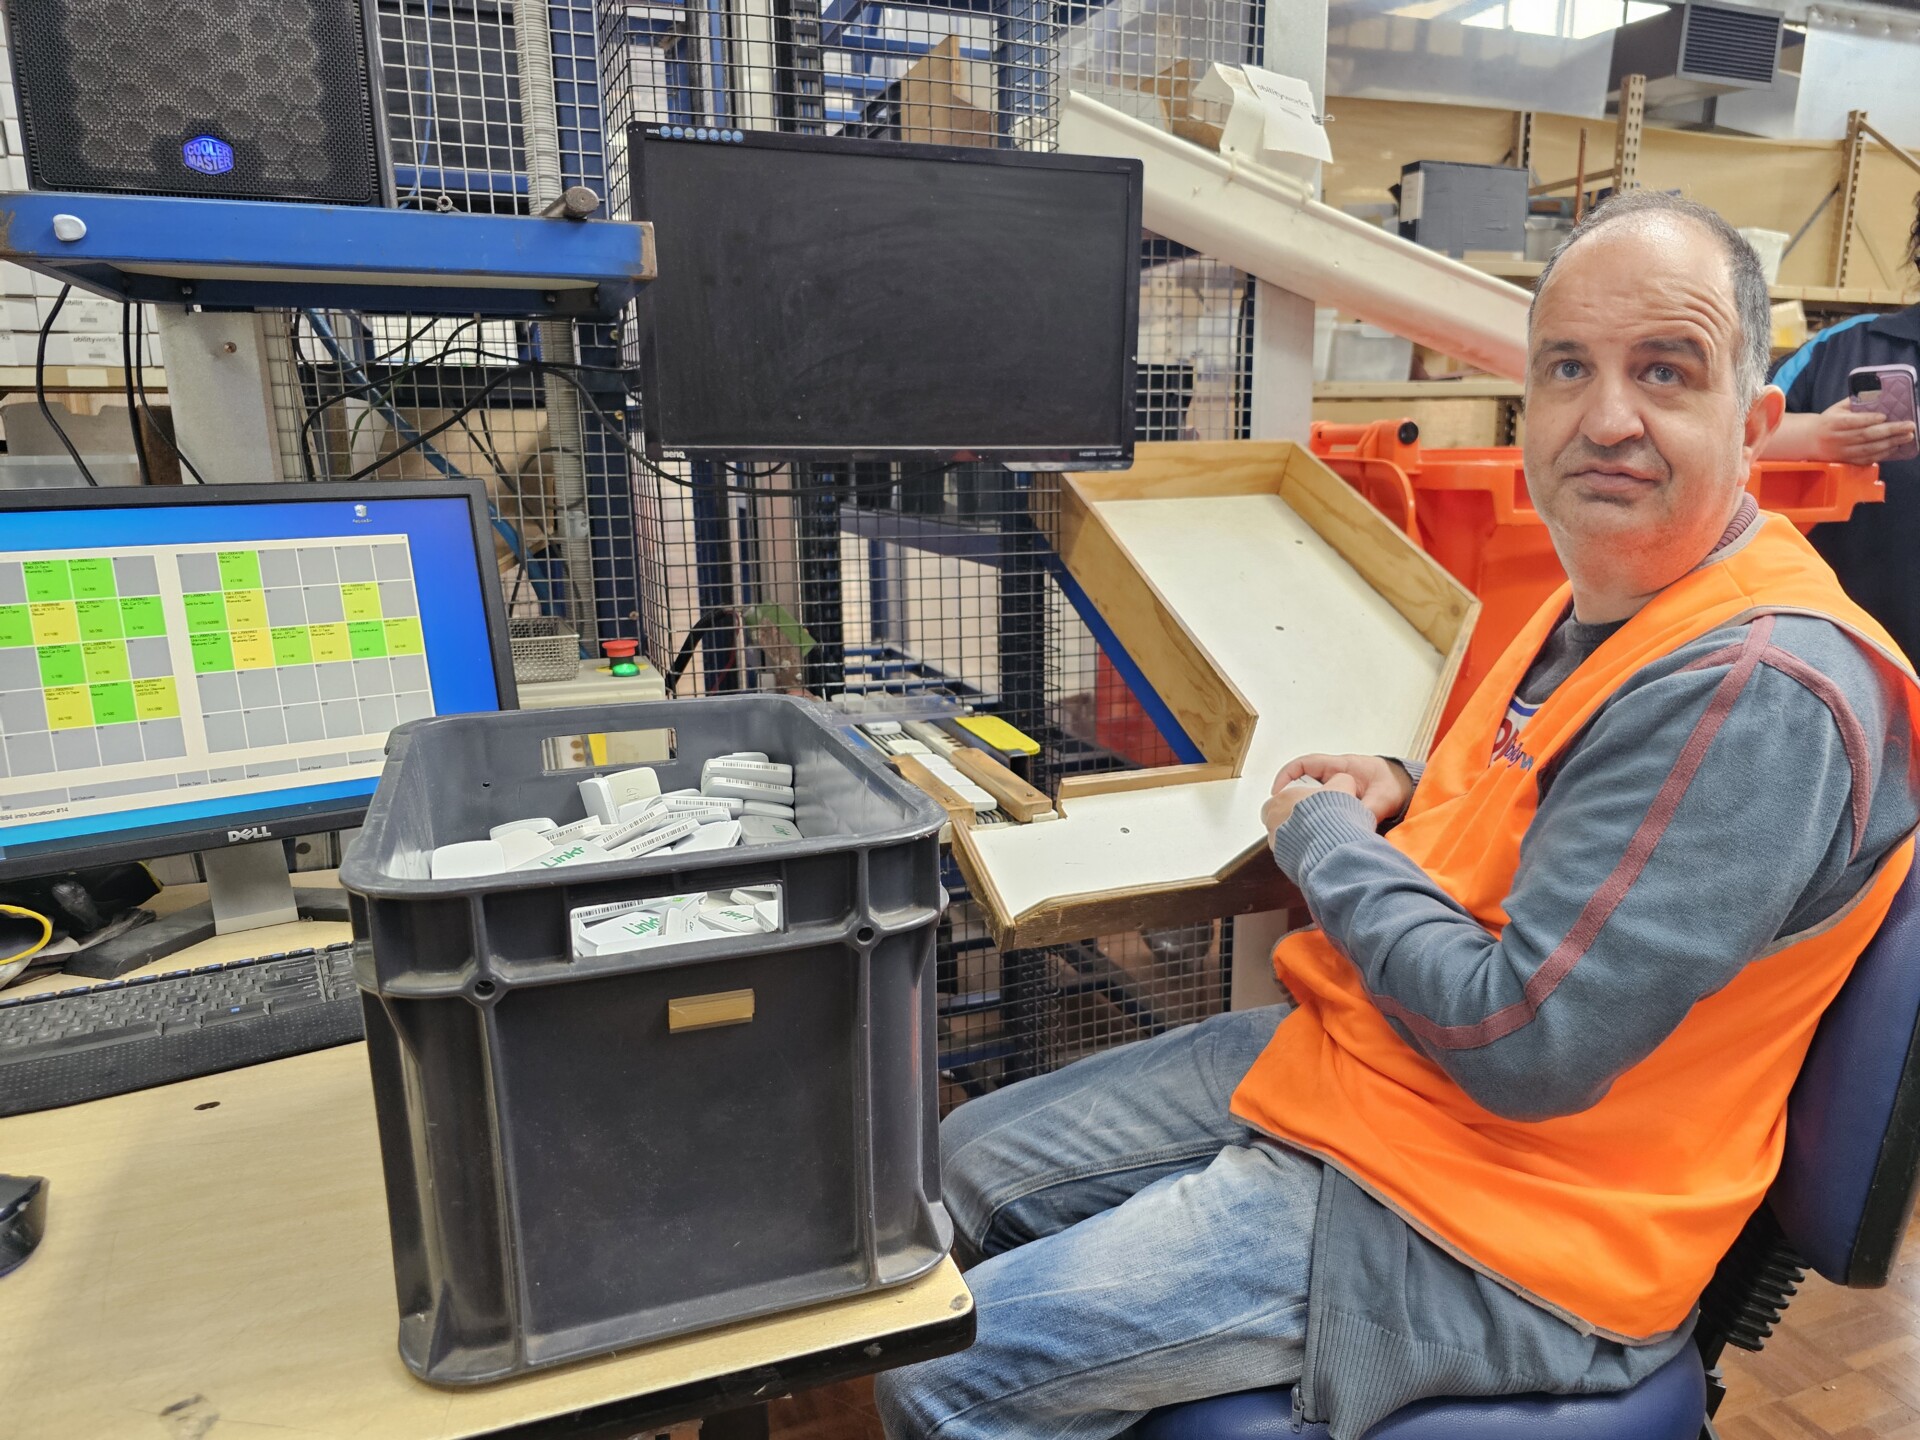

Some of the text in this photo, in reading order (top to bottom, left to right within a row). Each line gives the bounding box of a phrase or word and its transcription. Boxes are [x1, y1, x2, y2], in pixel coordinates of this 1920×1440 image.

[187, 140, 229, 157] COOLER
[188, 154, 231, 171] MASTER
[663, 450, 686, 459] BenQ
[28, 809, 56, 817] location
[227, 825, 272, 843] DELL
[540, 846, 585, 868] Linkt
